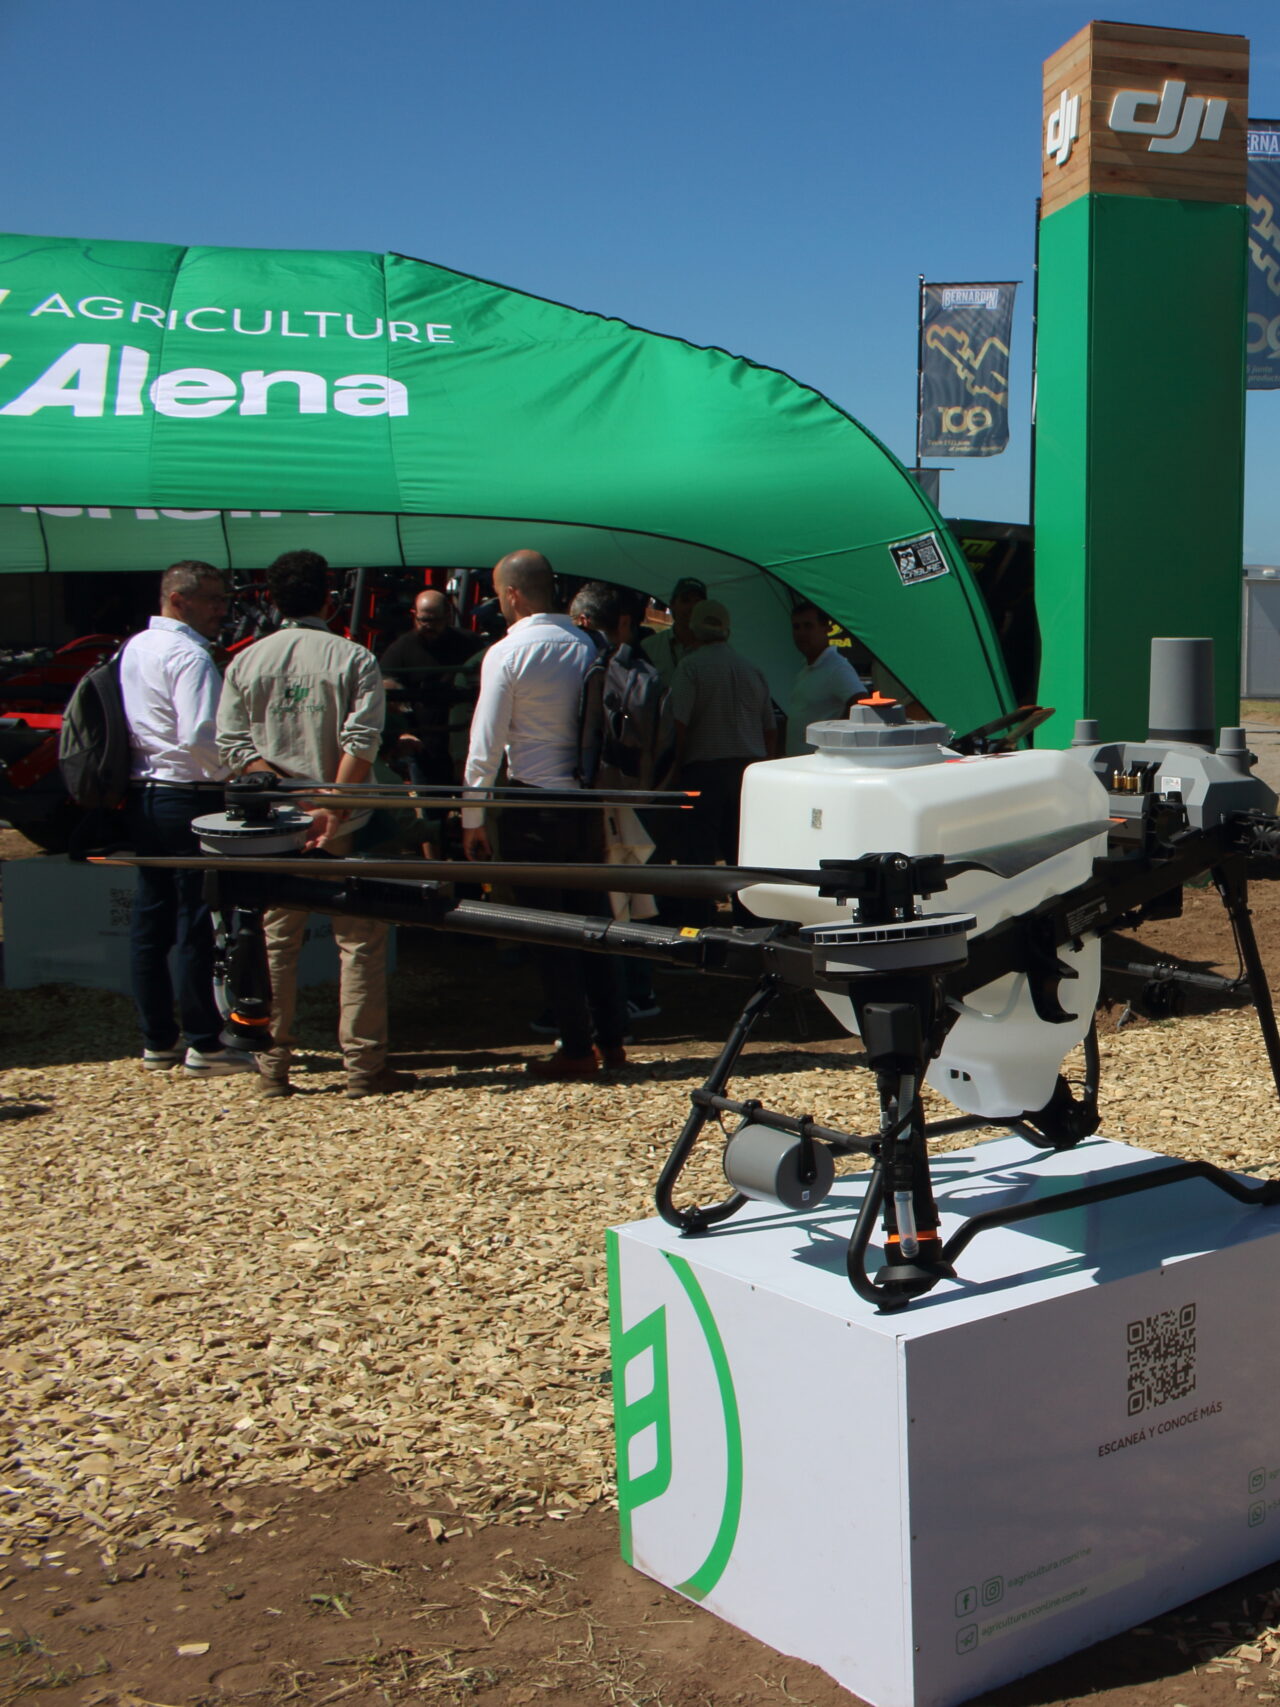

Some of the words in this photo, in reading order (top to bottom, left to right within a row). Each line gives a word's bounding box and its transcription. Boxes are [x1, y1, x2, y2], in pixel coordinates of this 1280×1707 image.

[30, 292, 454, 343] AGRICULTURE
[944, 290, 997, 309] BERNARDIN
[0, 343, 408, 417] Alena
[1098, 1428, 1147, 1457] ESCANEÁ
[1148, 1427, 1155, 1438] Y
[1157, 1408, 1199, 1435] CONOCÉ
[1200, 1400, 1223, 1419] MÁS
